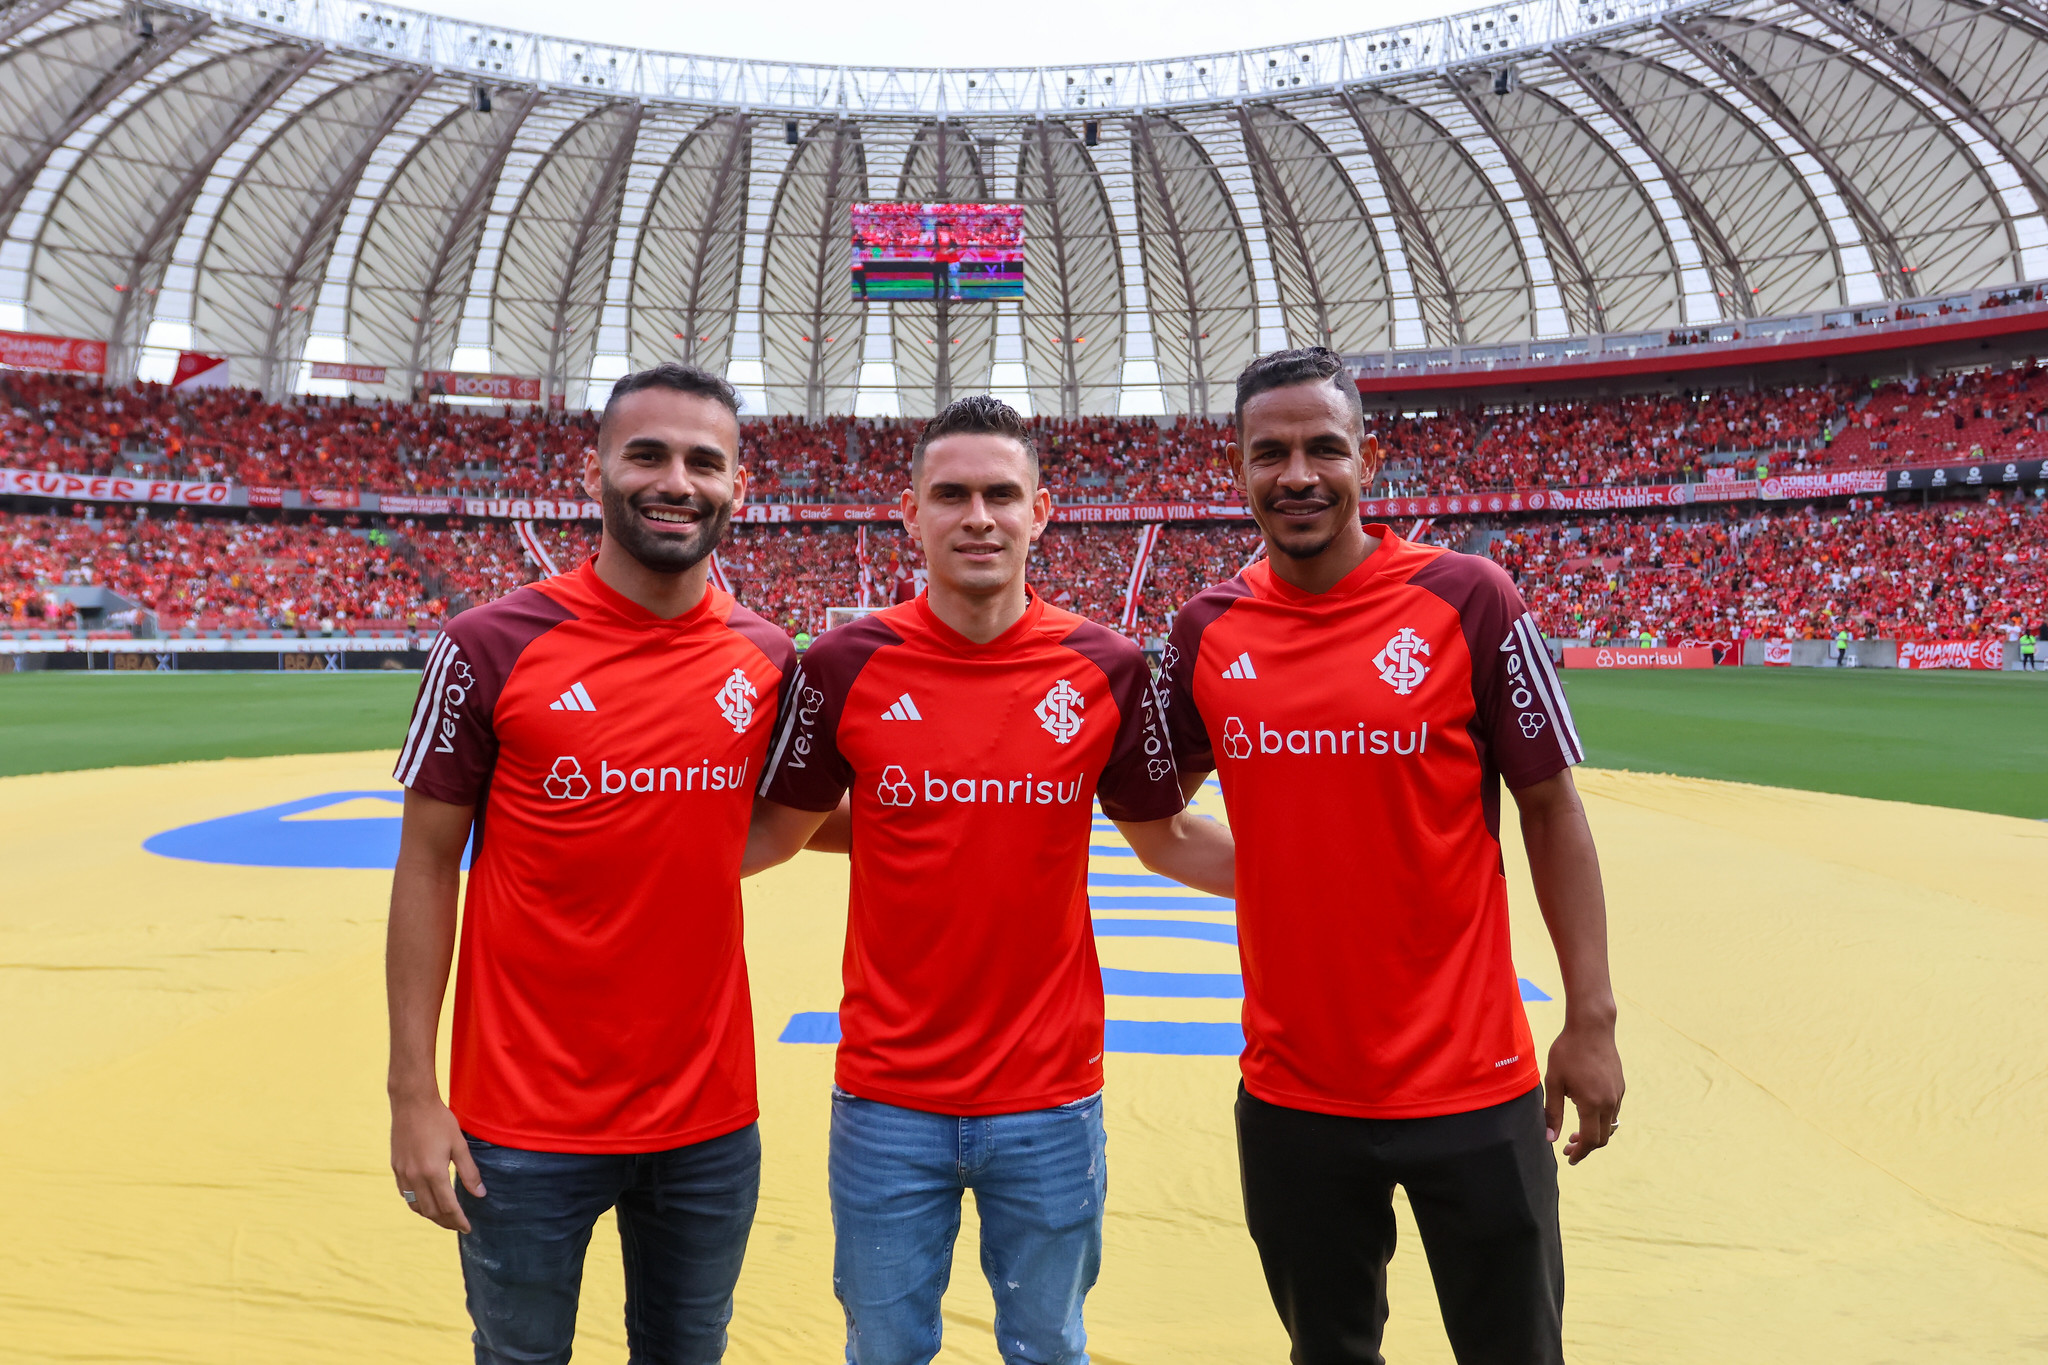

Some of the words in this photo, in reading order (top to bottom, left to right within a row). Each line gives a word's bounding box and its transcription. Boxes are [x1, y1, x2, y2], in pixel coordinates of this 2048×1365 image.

[455, 378, 510, 395] ROOTS
[14, 473, 134, 498] SUPER
[149, 483, 228, 502] FICO
[1579, 487, 1649, 498] CONSULADO
[465, 499, 602, 519] GUARDA
[1565, 497, 1608, 510] PASSO
[800, 508, 828, 519] Claro
[844, 508, 872, 519] Claro
[1069, 509, 1103, 521] INTER
[1105, 509, 1130, 521] POR
[1133, 506, 1164, 519] TODA
[1167, 505, 1195, 519] VIDA
[114, 653, 171, 671] BRAX
[284, 653, 338, 671] BRAX
[1616, 651, 1682, 666] banrisul
[1500, 631, 1533, 709] vero
[434, 684, 467, 755] vero
[1259, 721, 1429, 755] banrisul
[600, 756, 749, 794] banrisul
[924, 770, 1085, 806] banrisul
